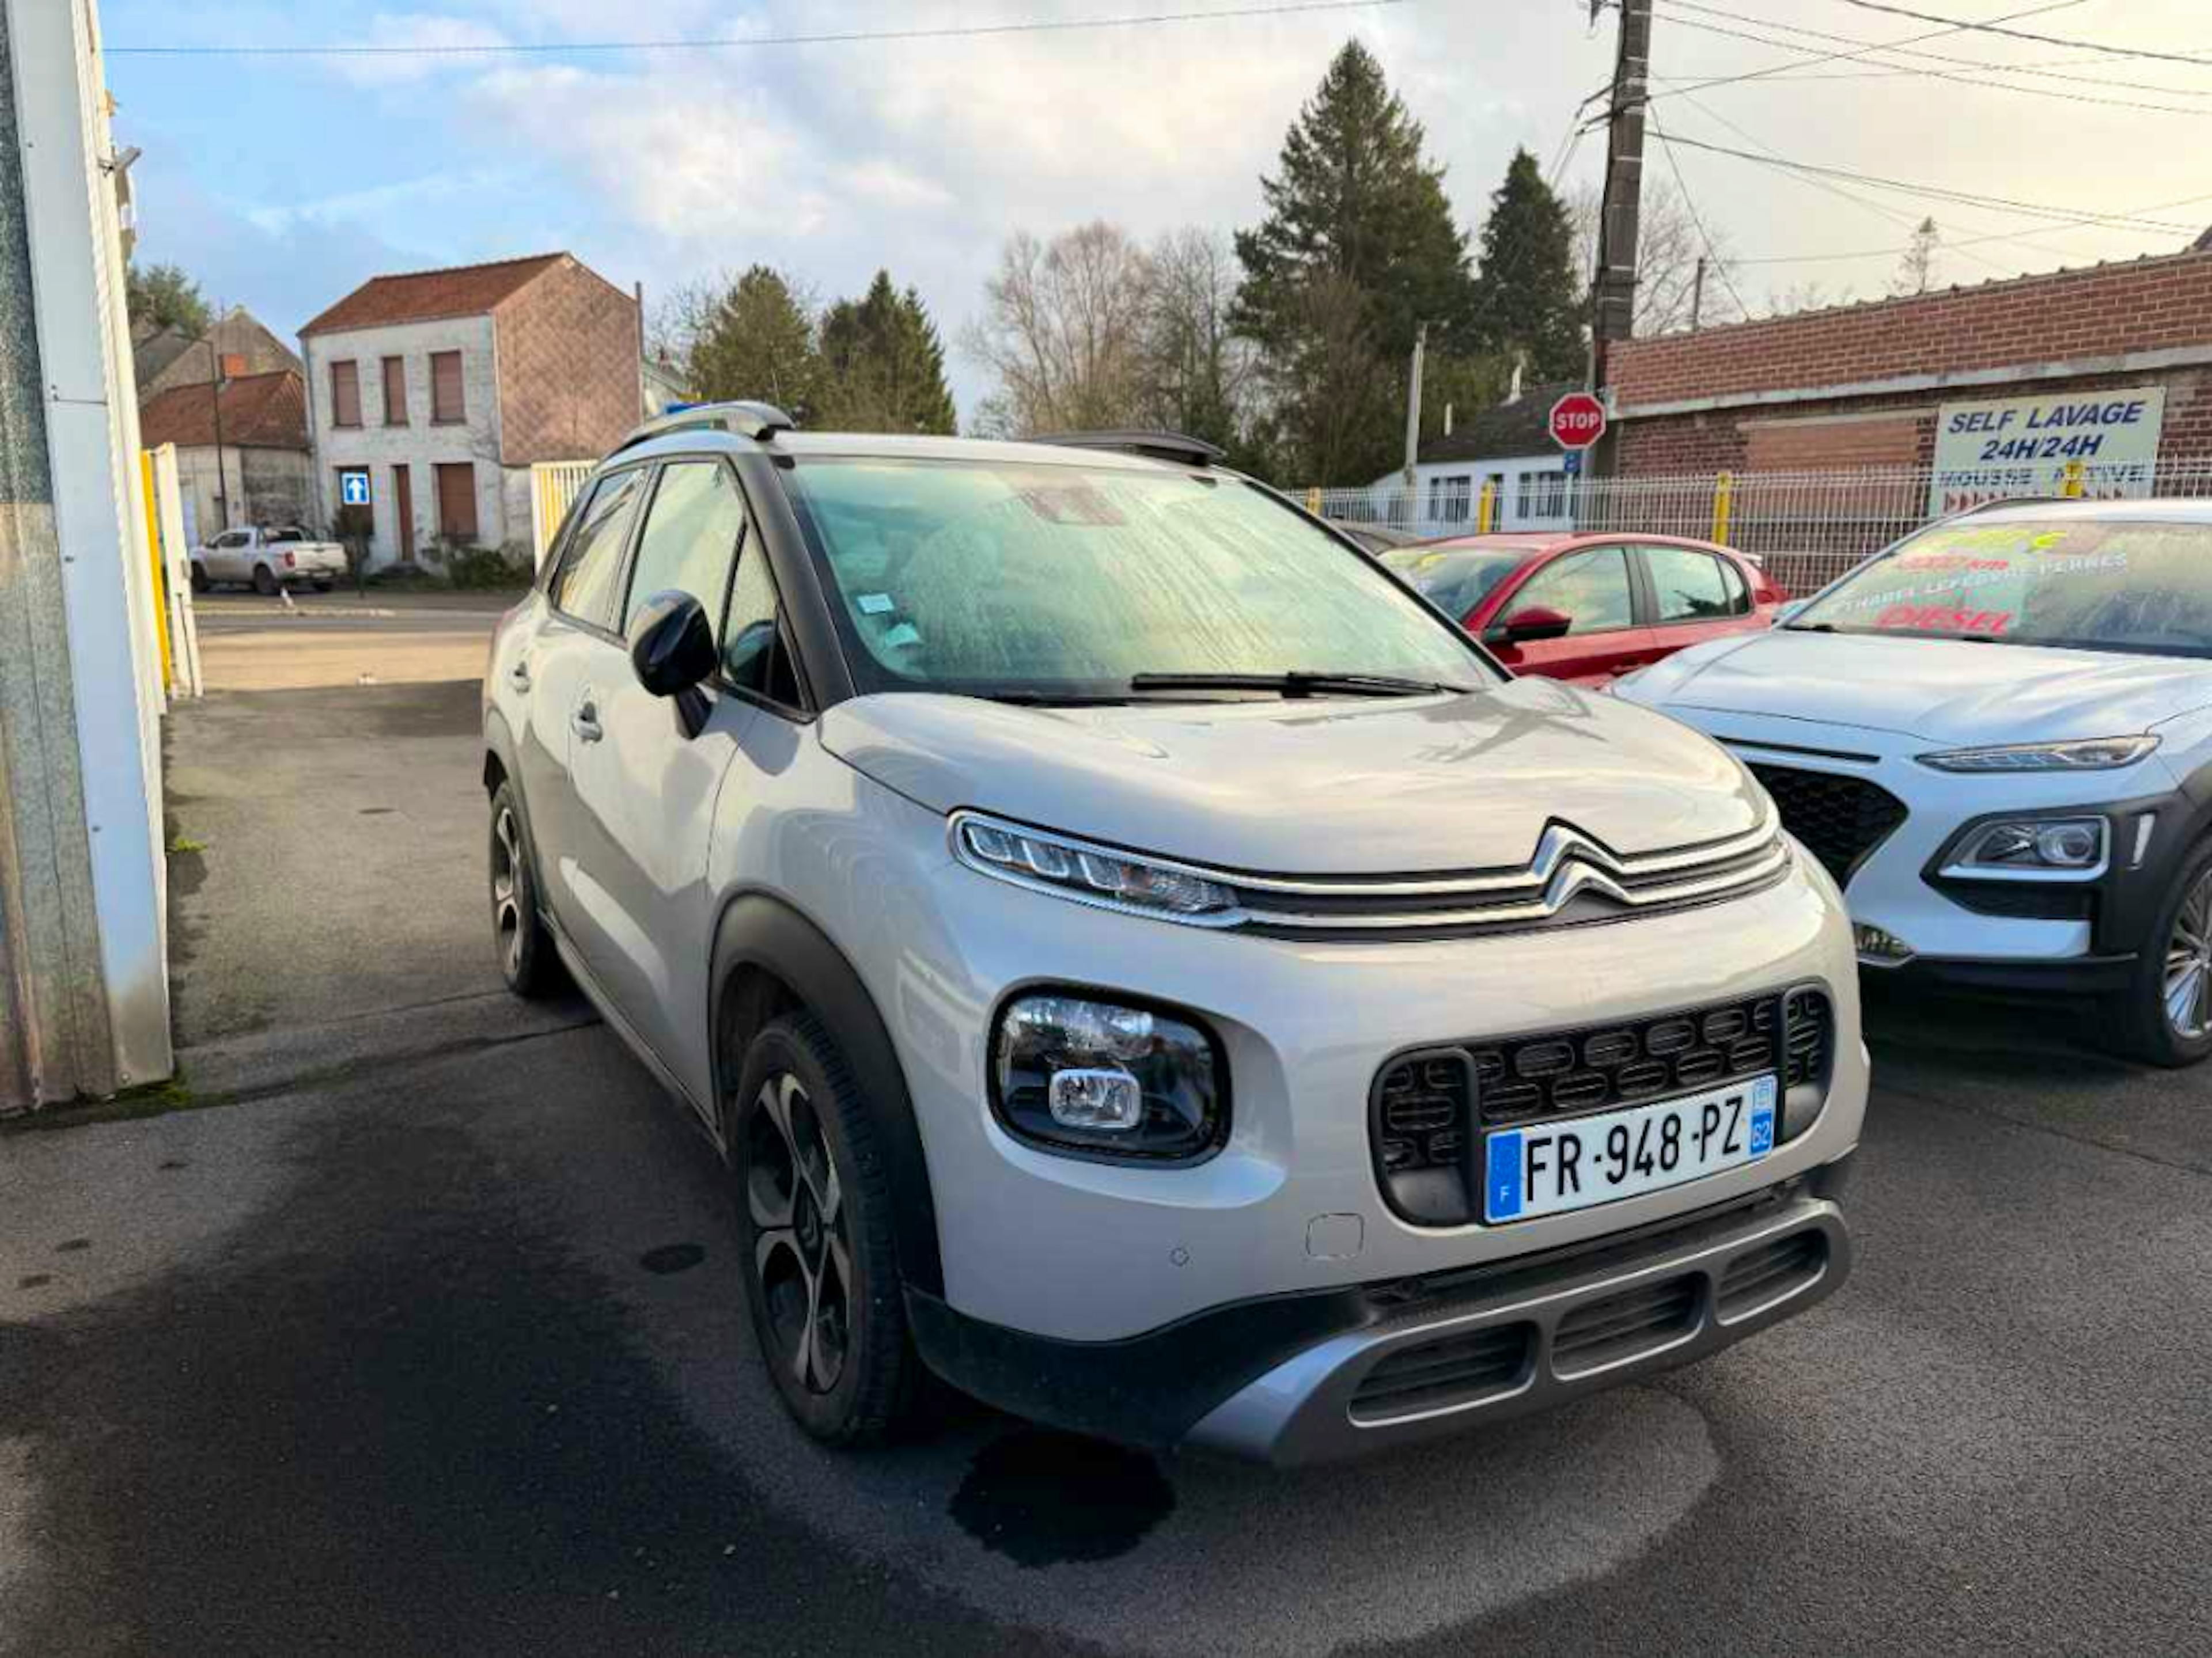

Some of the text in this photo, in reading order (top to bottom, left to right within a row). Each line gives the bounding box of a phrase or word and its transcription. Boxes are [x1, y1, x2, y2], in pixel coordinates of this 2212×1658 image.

[1556, 412, 1600, 430] STOP
[1948, 401, 2145, 434] SELF LAVAGE
[1980, 434, 2104, 461] 24H/24H
[2053, 464, 2146, 484] ATIVE
[1876, 605, 2012, 633] DIESEL
[1499, 1185, 1510, 1202] F
